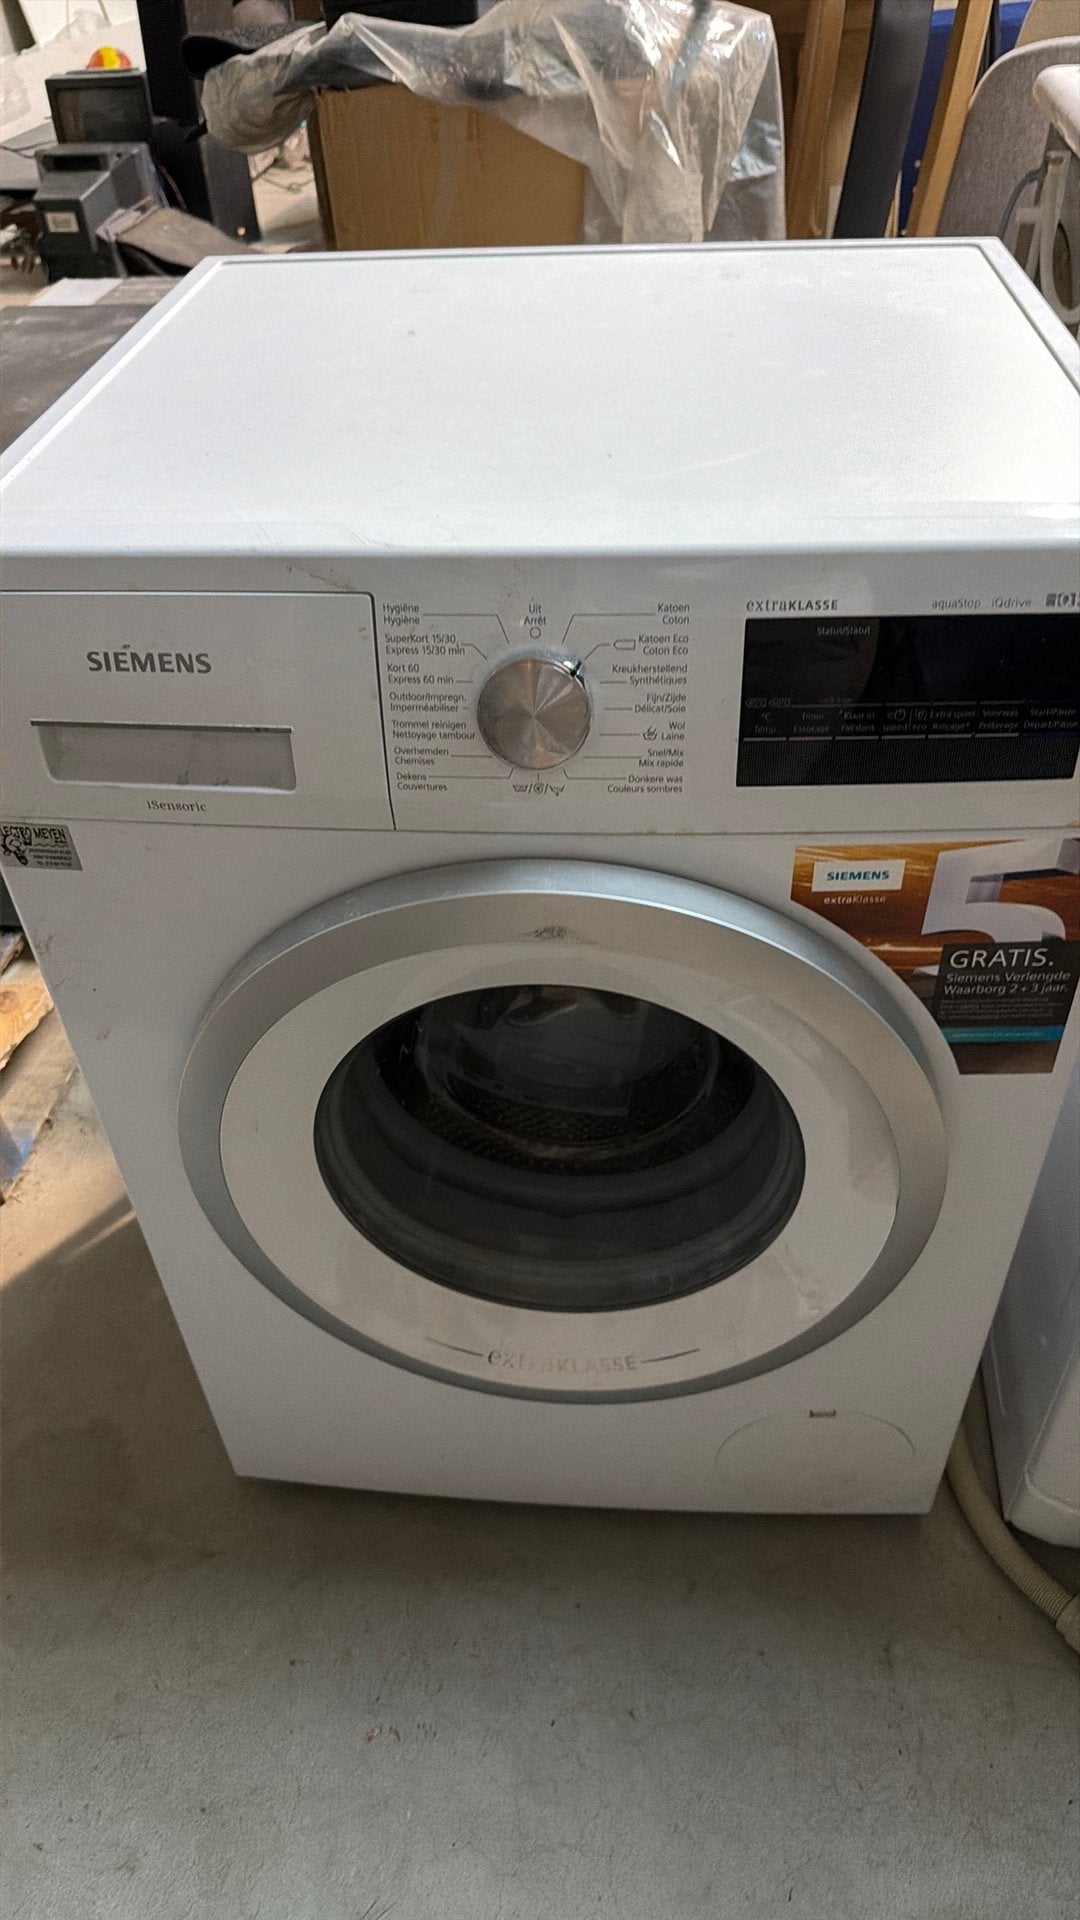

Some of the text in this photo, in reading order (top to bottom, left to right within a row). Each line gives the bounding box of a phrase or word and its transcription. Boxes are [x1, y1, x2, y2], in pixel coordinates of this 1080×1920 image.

[657, 603, 690, 613] Katoen
[746, 598, 838, 611] extraKLASSE
[932, 596, 1031, 610] aquaStop iQdrive
[529, 604, 541, 614] Uit
[524, 615, 546, 626] Arrêt
[663, 615, 689, 625] Coton
[385, 633, 429, 645] SuperKort
[639, 634, 689, 644] Katoen Eco
[386, 645, 465, 656] Express 15/30 min
[643, 646, 689, 655] Coton Eco
[87, 651, 212, 674] SIEMENS
[387, 663, 419, 673] Kort 60
[612, 664, 687, 674] Kreukherstellend
[388, 674, 454, 686] Express 60 min
[630, 676, 687, 687] Synthétiques
[389, 692, 467, 704] Outdoor/Impregn.
[646, 693, 686, 704] Fijn/Zijde
[391, 703, 459, 714] Imperméabiliser
[634, 703, 686, 714] Délicat/Soie
[391, 720, 466, 732] Trommel reinigen
[668, 721, 685, 731] Wol
[393, 730, 475, 741] Nettoyage tambour
[661, 731, 685, 740] Laine
[394, 747, 449, 756] Overhemden
[648, 748, 684, 758] Snel/Mix
[395, 756, 435, 766] Chemises
[639, 758, 684, 769] Mix rapide
[397, 772, 426, 781] Dekens
[628, 774, 683, 784] Donkere was
[398, 782, 447, 792] Couvertures
[607, 784, 683, 793] Couleurs sombres
[147, 799, 207, 812] iSensoric
[33, 828, 66, 840] MEYEN
[827, 870, 890, 882] SIEMENS
[824, 895, 887, 905] extraKlasse
[950, 948, 1054, 969] GRATIS.
[946, 972, 1071, 983] Siemens Verlengde
[944, 983, 1005, 996] Waarborg
[1009, 984, 1019, 994] 2
[1031, 983, 1039, 993] 3
